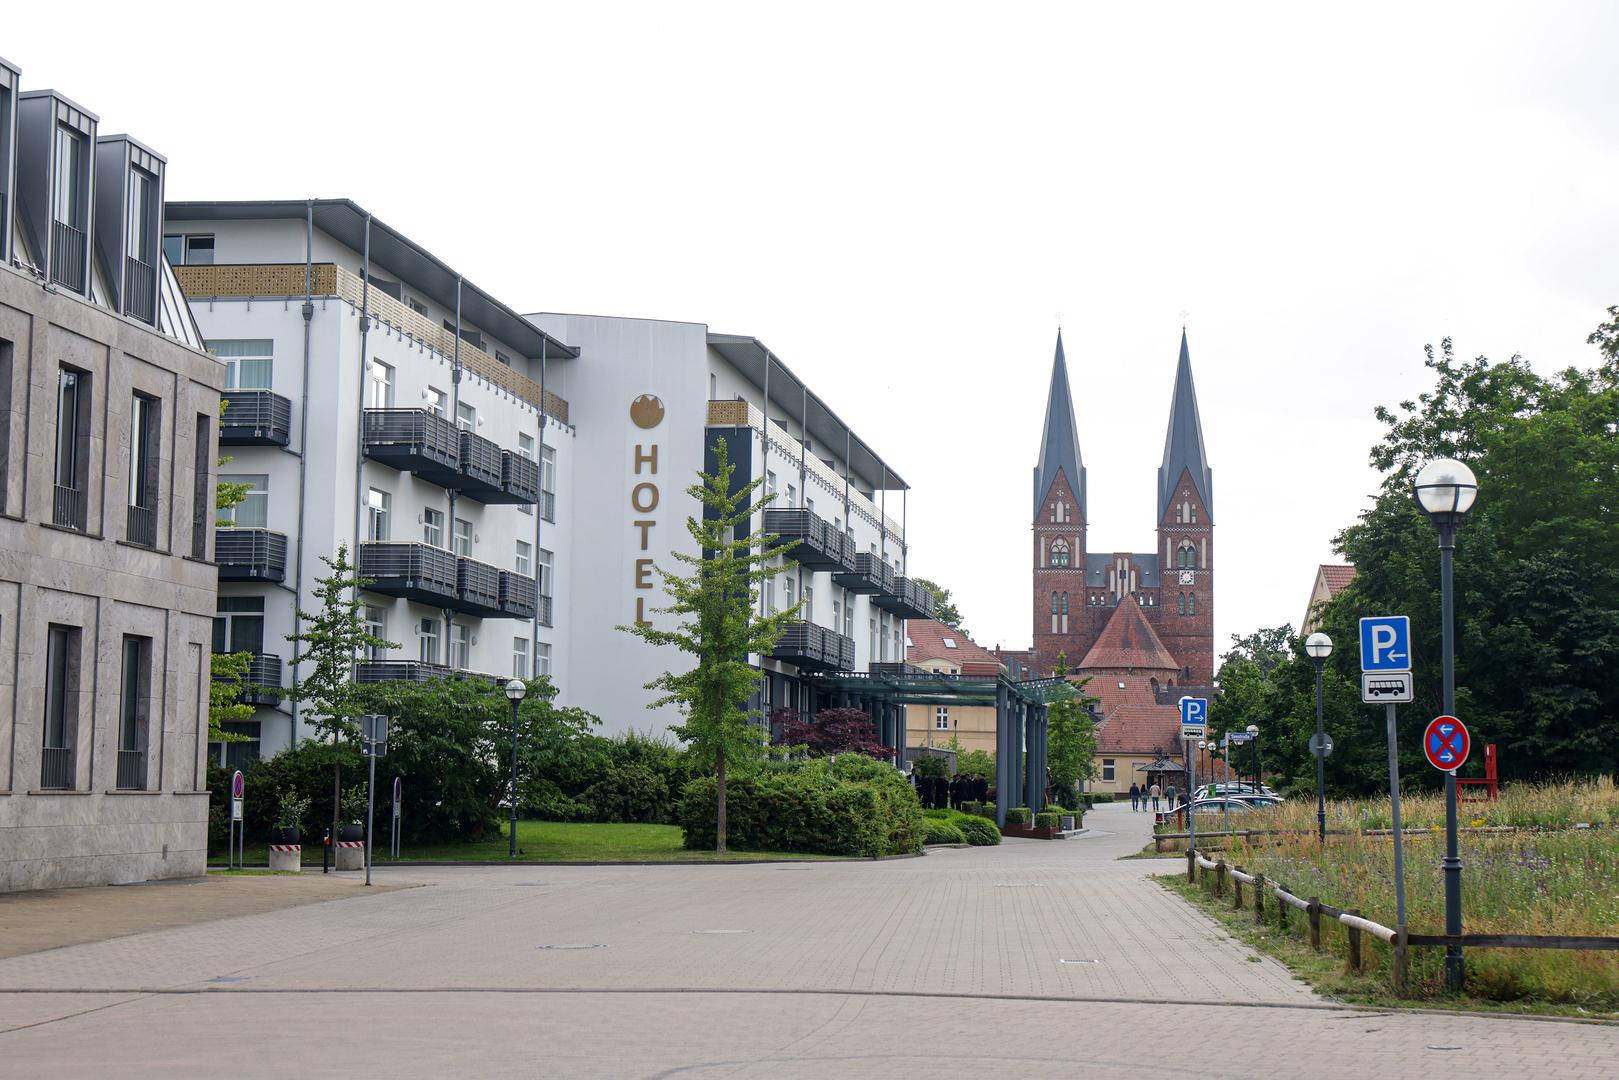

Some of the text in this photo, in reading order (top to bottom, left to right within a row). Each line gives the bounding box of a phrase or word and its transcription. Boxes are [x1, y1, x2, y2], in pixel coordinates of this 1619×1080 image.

[631, 444, 660, 627] HOTEL
[1371, 624, 1397, 664] P
[1187, 702, 1201, 721] P
